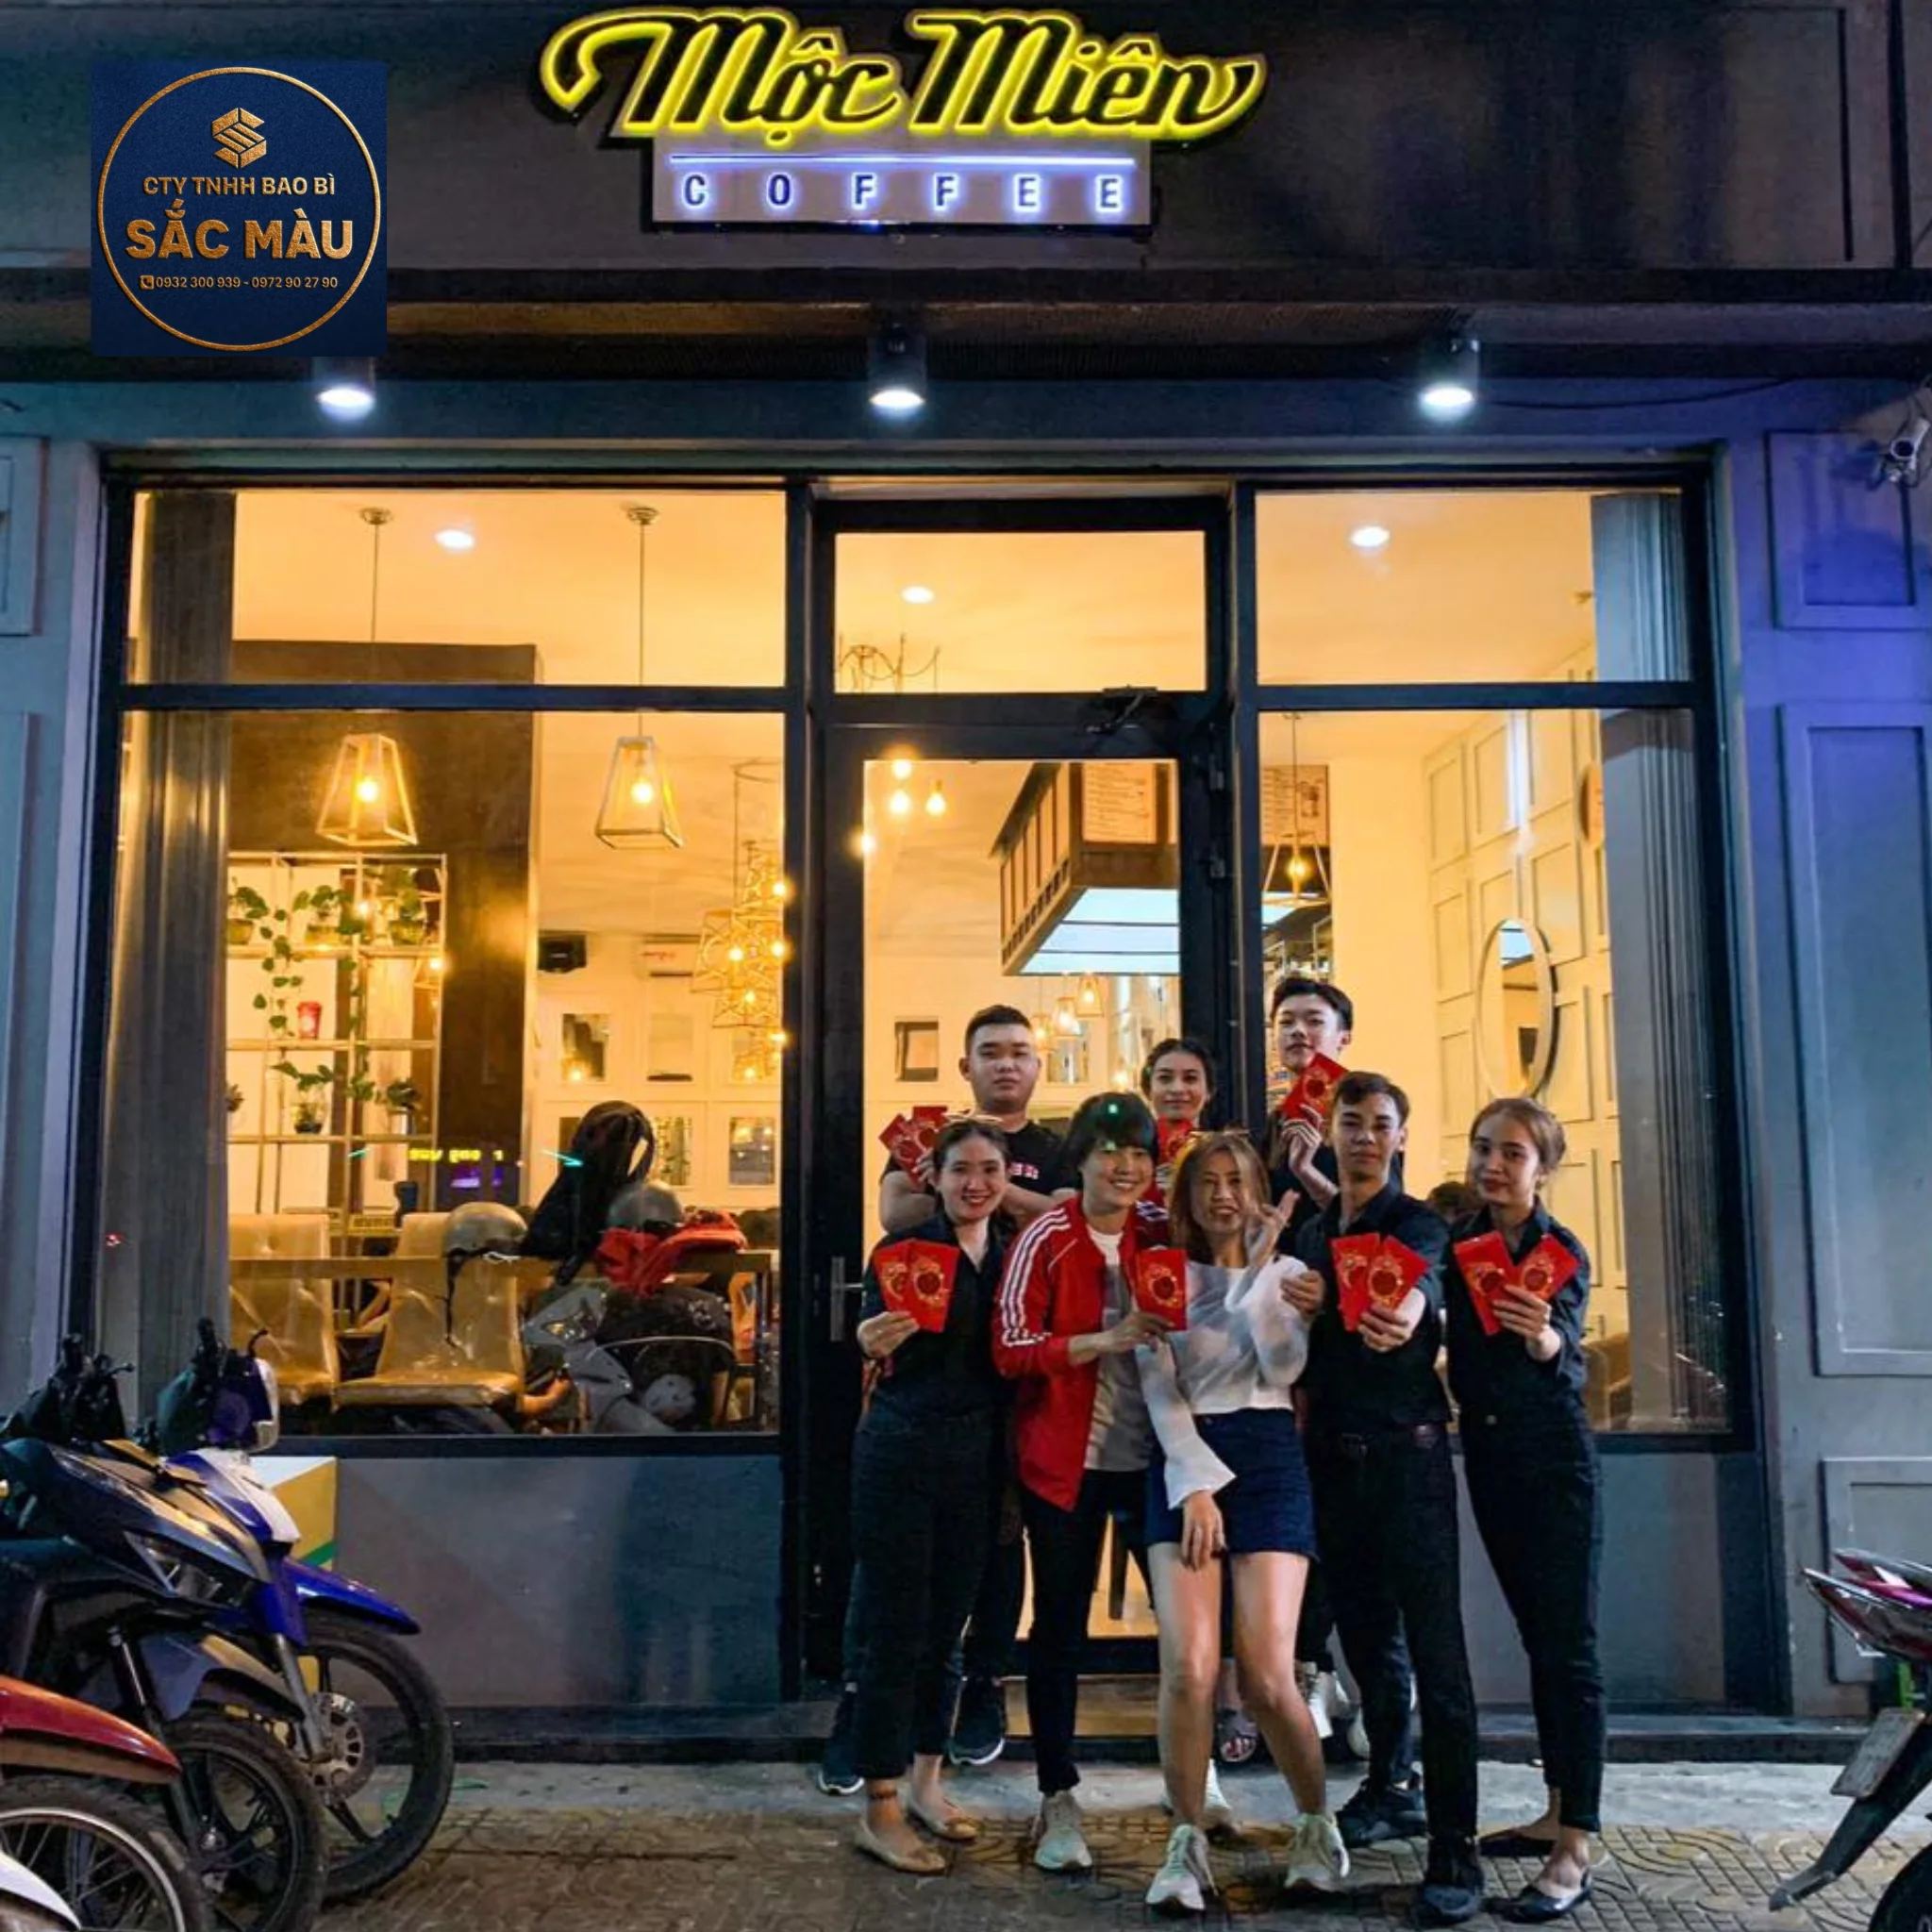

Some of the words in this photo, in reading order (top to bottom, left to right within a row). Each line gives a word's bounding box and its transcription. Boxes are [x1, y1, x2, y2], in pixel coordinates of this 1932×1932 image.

[541, 8, 902, 147] Mộc
[908, 10, 1267, 139] Miên
[680, 174, 1124, 211] COFFEE
